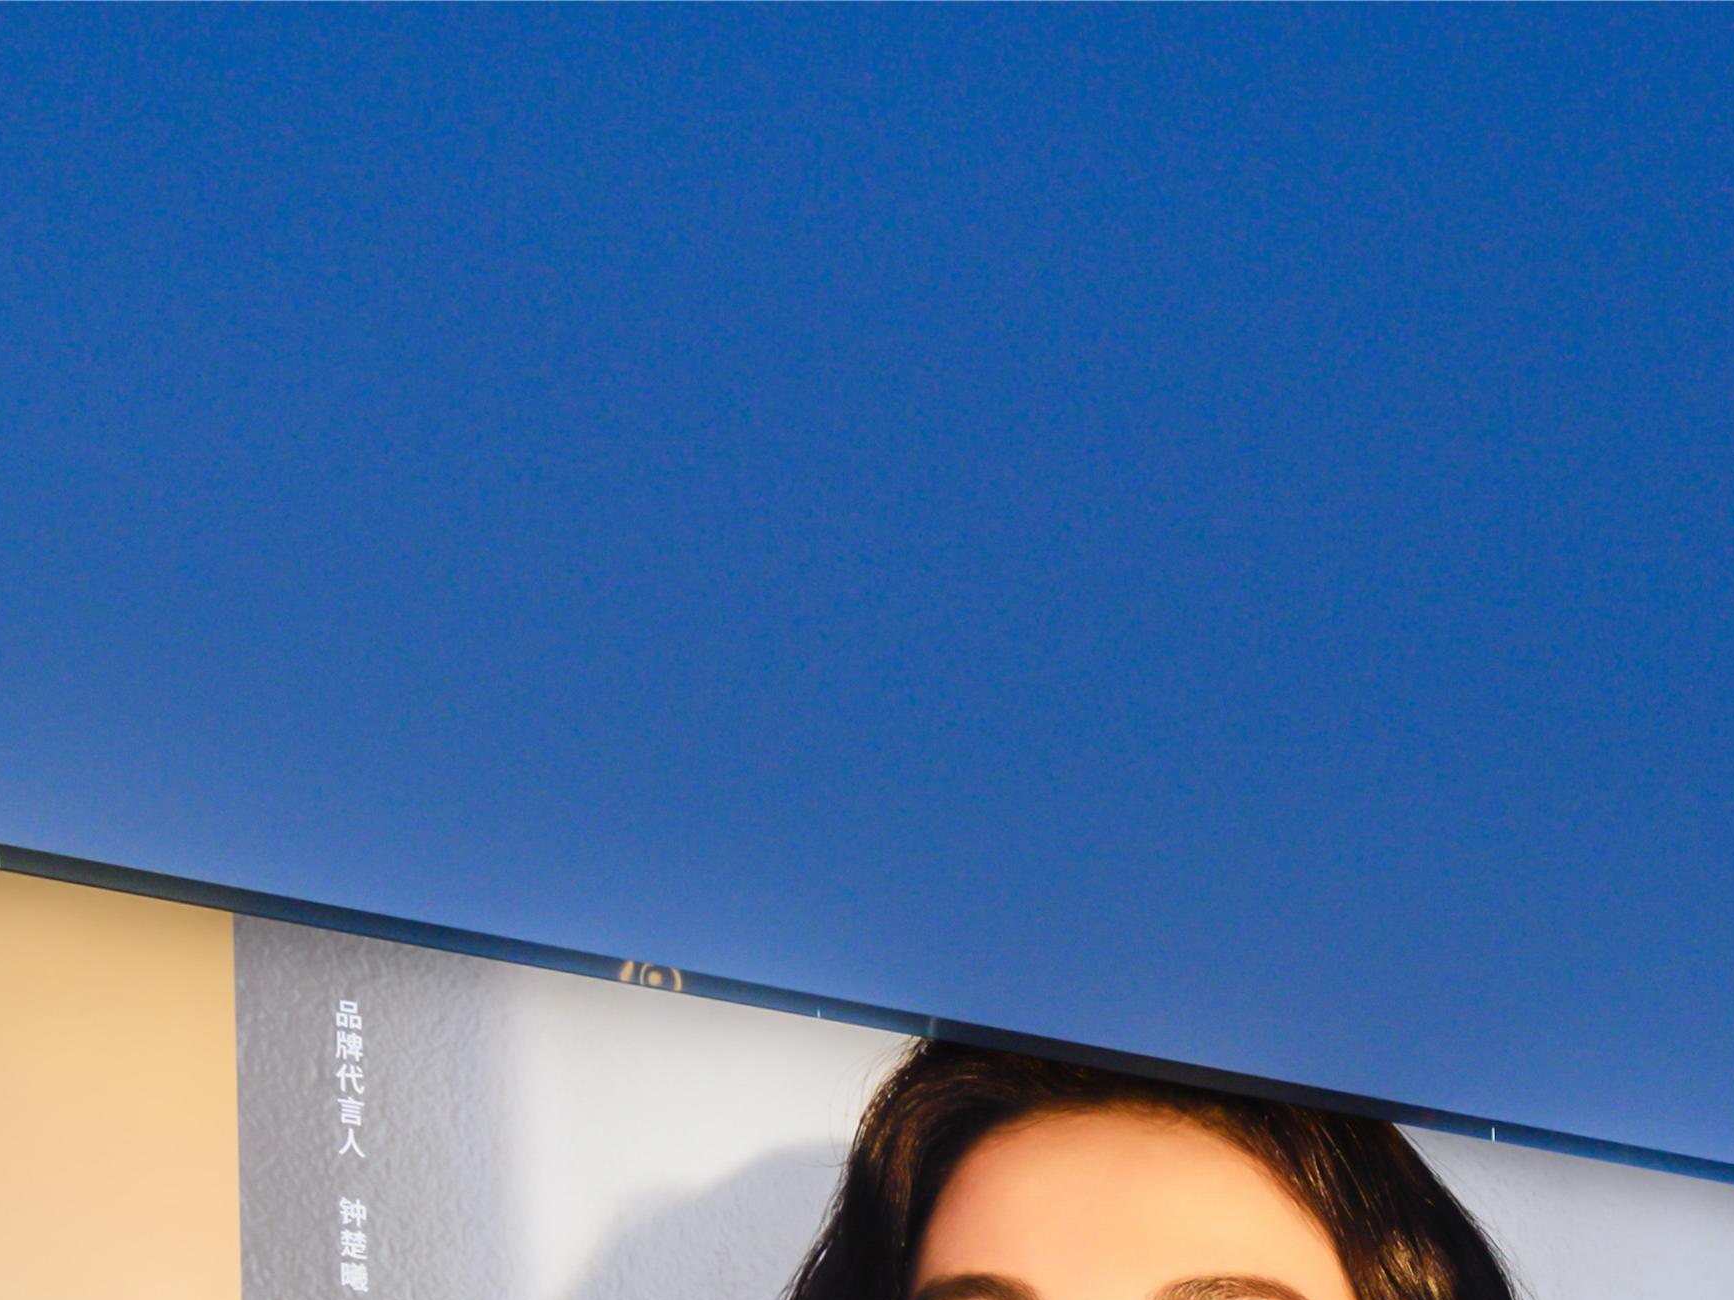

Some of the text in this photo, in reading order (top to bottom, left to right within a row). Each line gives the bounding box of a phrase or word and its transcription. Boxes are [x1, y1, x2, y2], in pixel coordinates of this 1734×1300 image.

[335, 1000, 366, 1158] 品牌代言人
